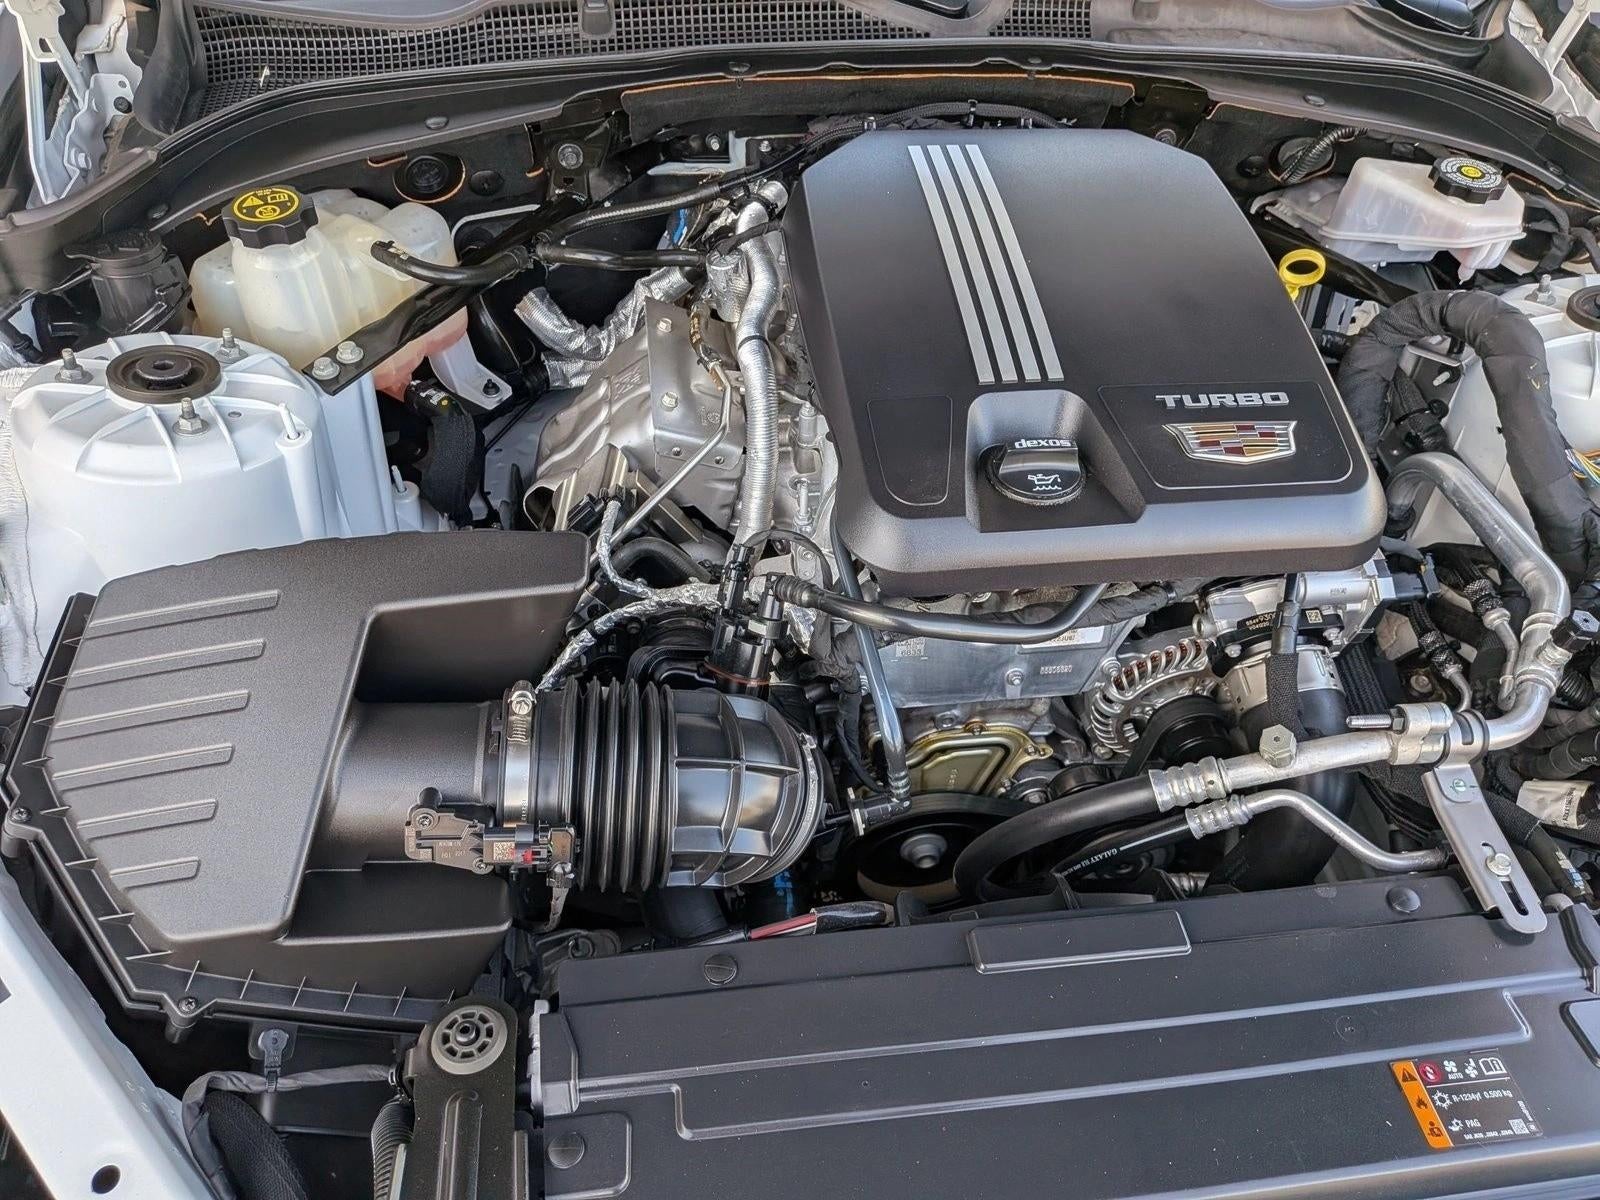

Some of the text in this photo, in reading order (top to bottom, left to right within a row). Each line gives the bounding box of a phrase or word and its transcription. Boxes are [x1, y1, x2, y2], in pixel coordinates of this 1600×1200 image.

[1155, 392, 1289, 409] TURBO
[1014, 438, 1071, 449] dexos
[1090, 848, 1118, 863] GALAXY
[1465, 1118, 1481, 1128] PAG
